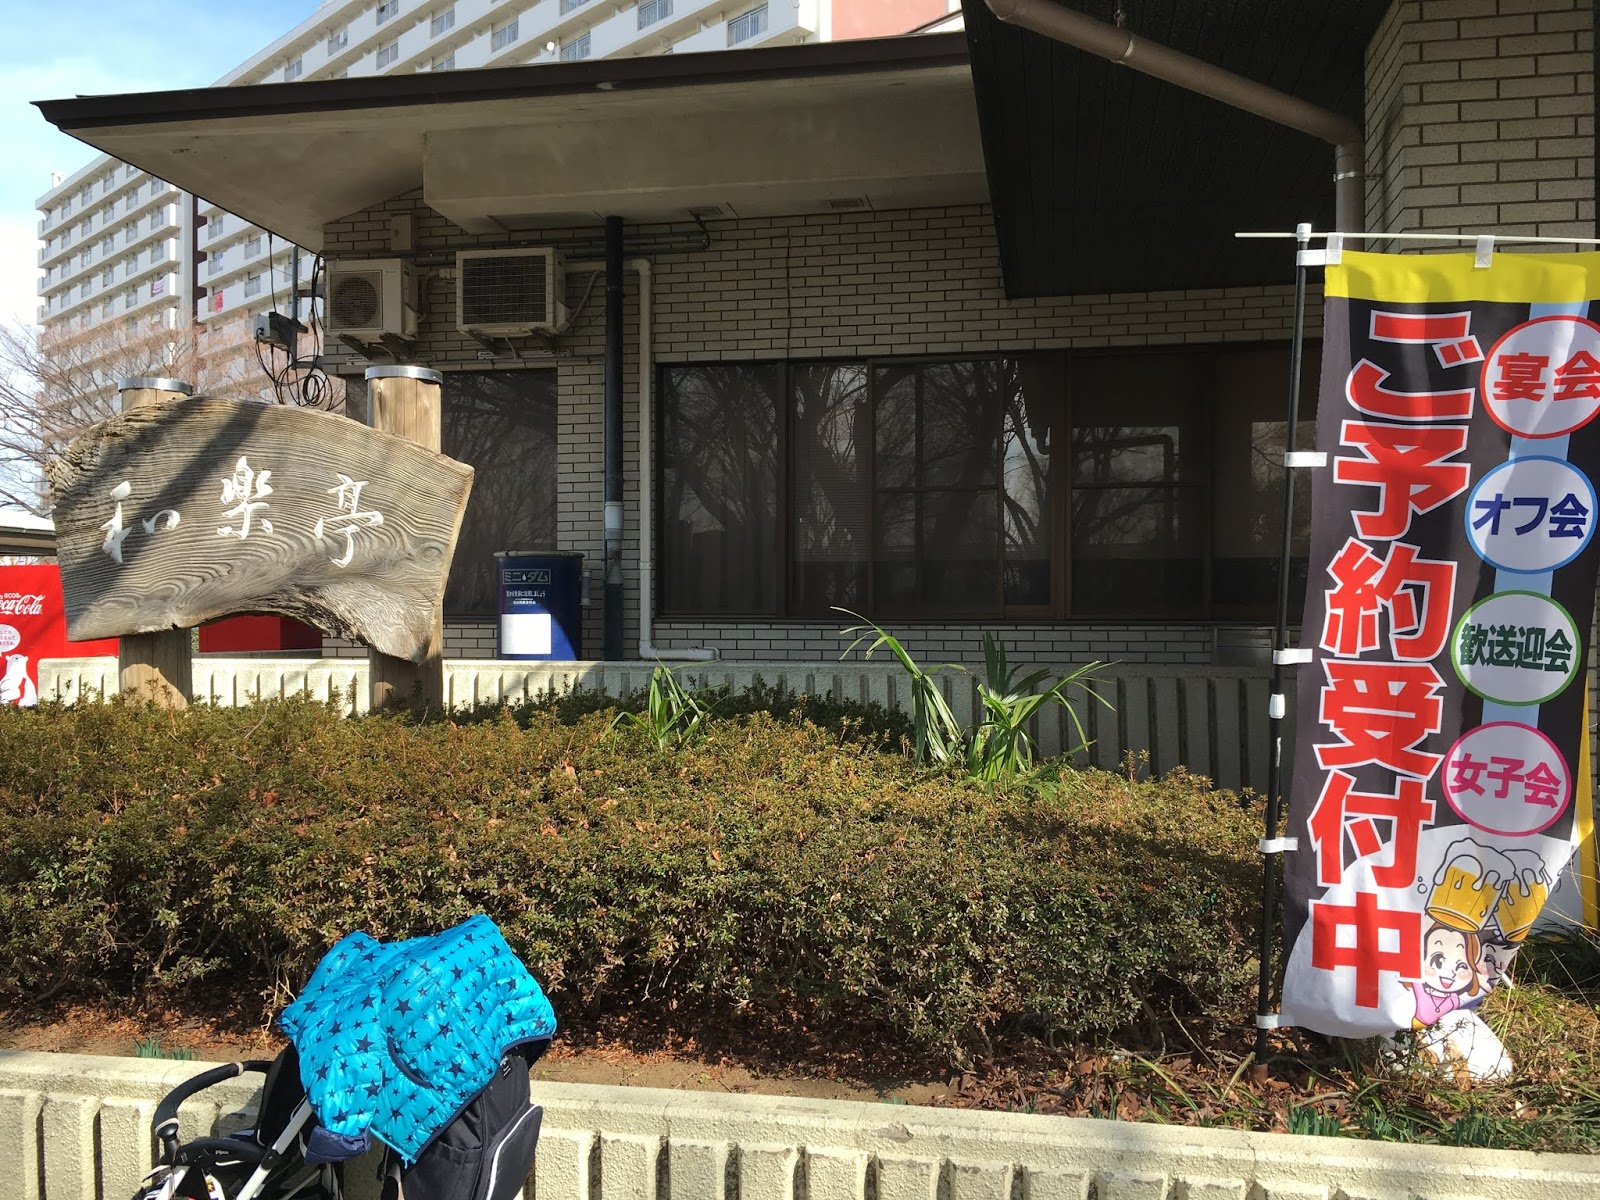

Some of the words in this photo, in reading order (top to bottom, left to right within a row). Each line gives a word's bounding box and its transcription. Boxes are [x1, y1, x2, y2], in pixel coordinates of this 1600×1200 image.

[1493, 350, 1600, 402] 宴会
[1472, 493, 1589, 540] オフ会
[1307, 309, 1485, 1009] ご予約受付中
[1459, 623, 1573, 674] 歓送迎会
[1449, 752, 1562, 809] 女子会
